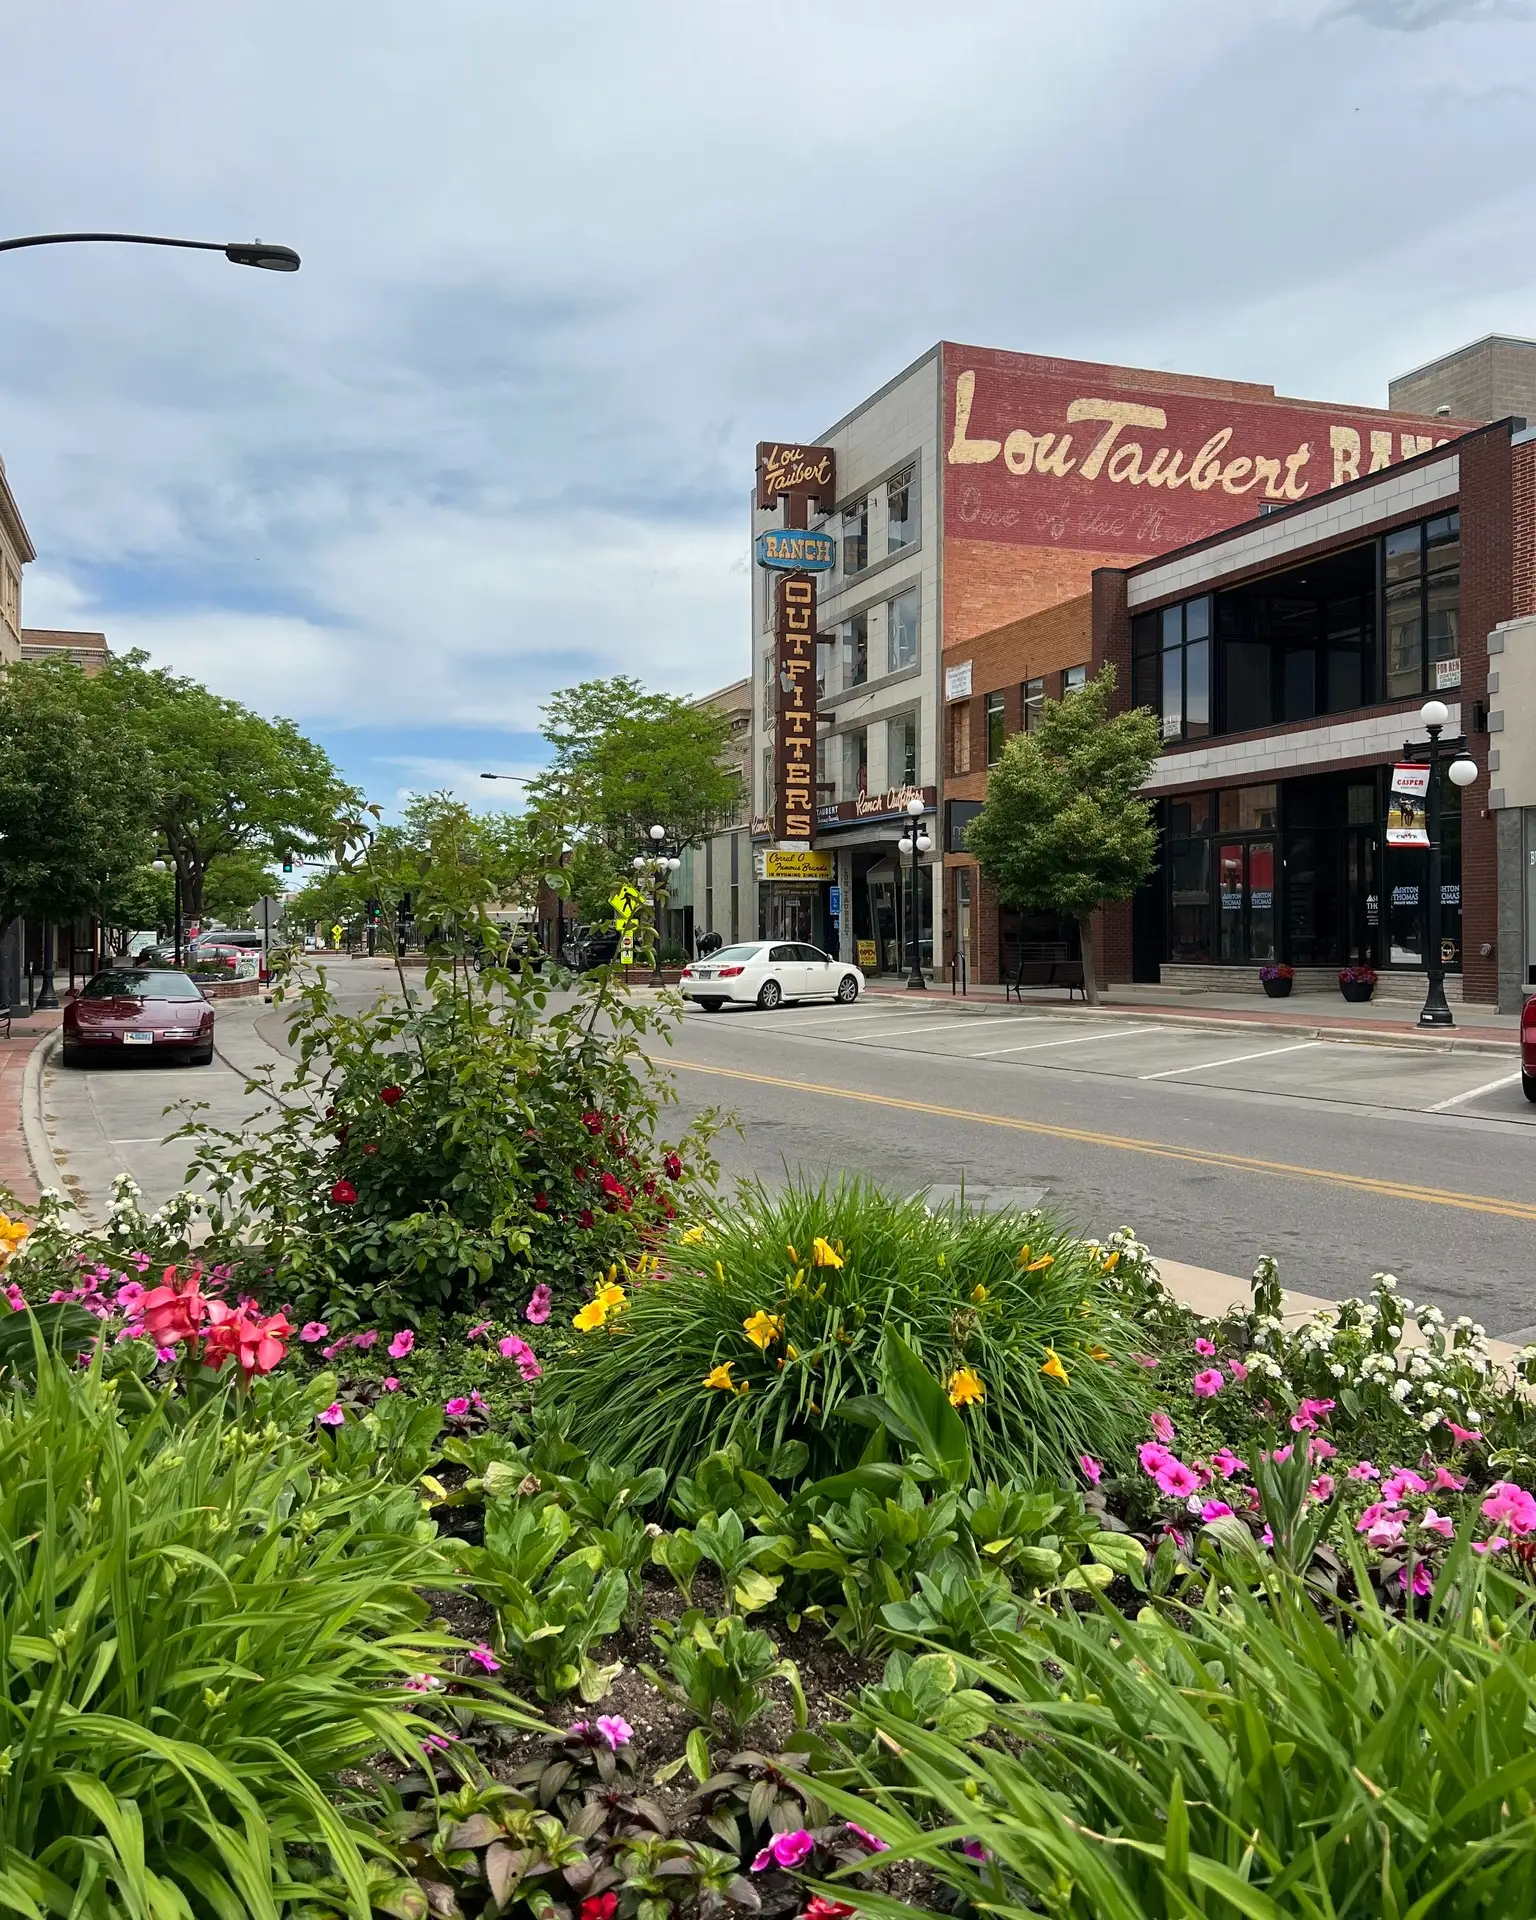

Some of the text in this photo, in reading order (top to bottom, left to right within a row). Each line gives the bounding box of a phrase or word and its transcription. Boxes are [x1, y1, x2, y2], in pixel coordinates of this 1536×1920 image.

[948, 370, 1076, 477] Lou
[1066, 398, 1309, 500] Taubert
[767, 445, 804, 471] Lou
[765, 456, 831, 495] Taubert
[766, 537, 831, 562] RANCH
[1437, 663, 1447, 674] FOR
[785, 581, 812, 836] OUTFITTERS
[1397, 779, 1424, 787] CASPER
[816, 806, 839, 817] TAUBERT
[856, 789, 882, 816] Ranch
[769, 853, 795, 863] Corral
[775, 862, 828, 872] Famous Brands
[1393, 886, 1419, 894] ASHTON
